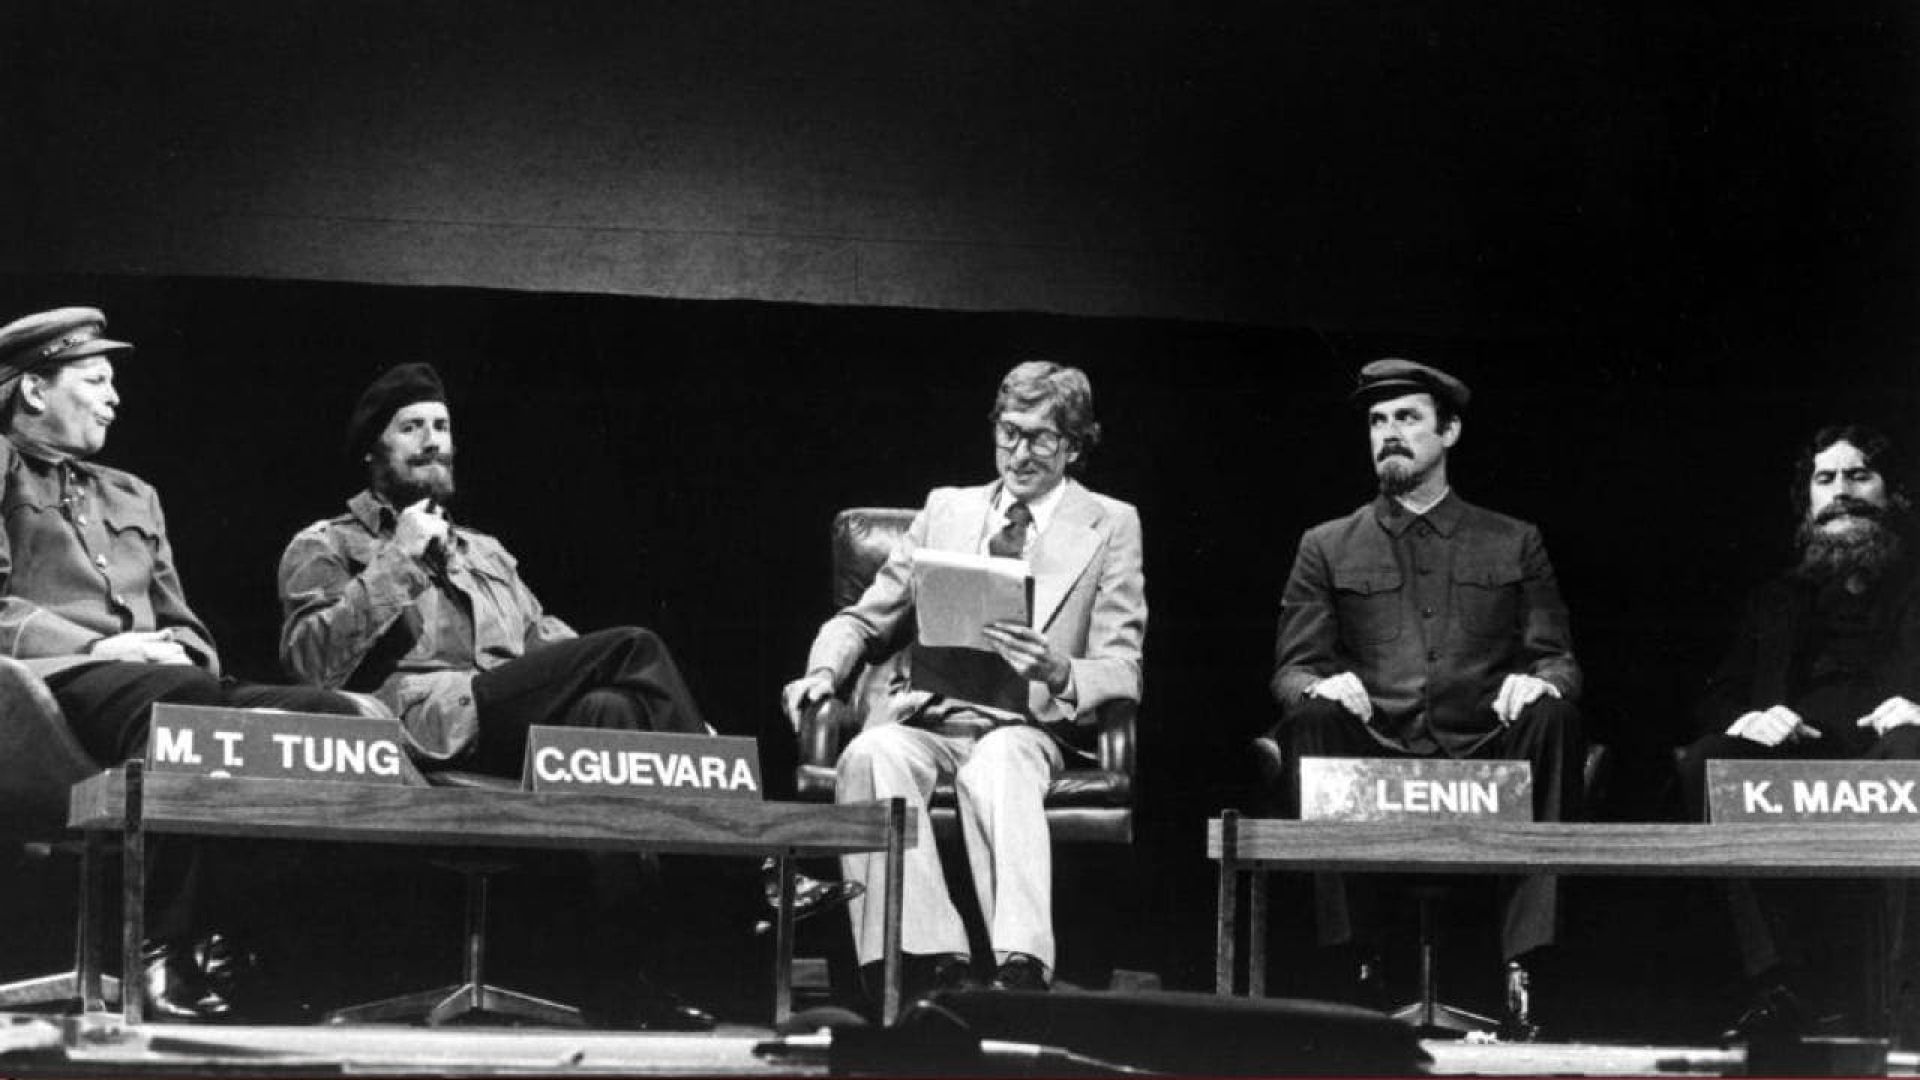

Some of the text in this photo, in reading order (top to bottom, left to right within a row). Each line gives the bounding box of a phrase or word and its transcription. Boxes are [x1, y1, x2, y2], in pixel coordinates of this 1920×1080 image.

[155, 726, 201, 764] M.
[272, 733, 400, 775] TUNG
[1376, 779, 1498, 813] LENIN
[1743, 777, 1919, 814] K. MARX
